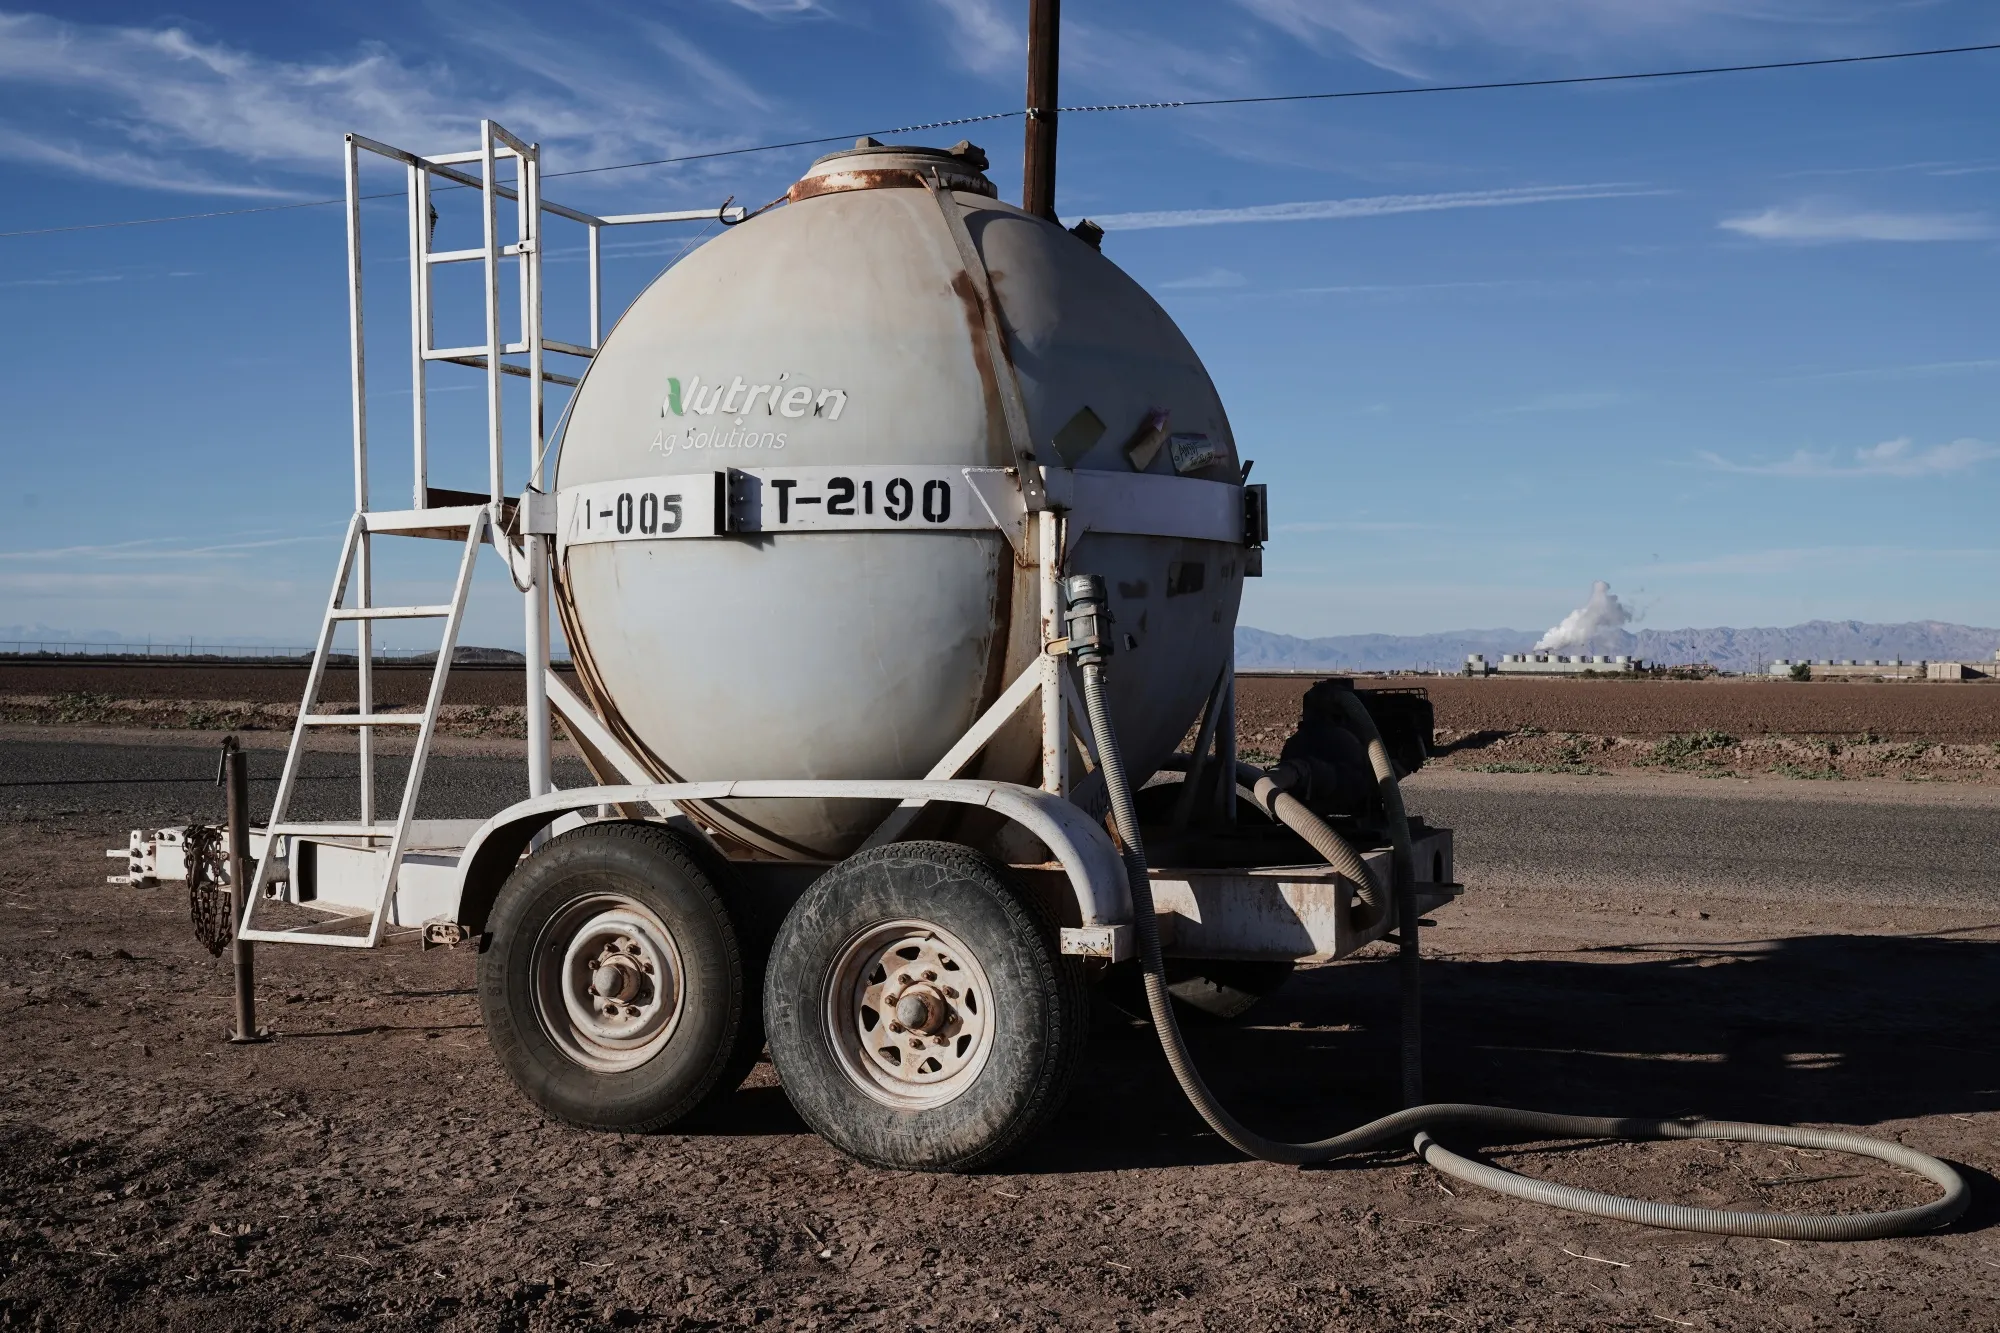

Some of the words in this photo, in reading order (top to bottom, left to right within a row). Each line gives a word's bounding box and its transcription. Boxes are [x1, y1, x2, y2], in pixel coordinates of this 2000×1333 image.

[661, 371, 848, 421] Nutrien
[649, 430, 677, 457] Ag
[682, 426, 788, 450] Solutions
[771, 476, 951, 524] T-2190
[490, 1005, 531, 1076] POWER
